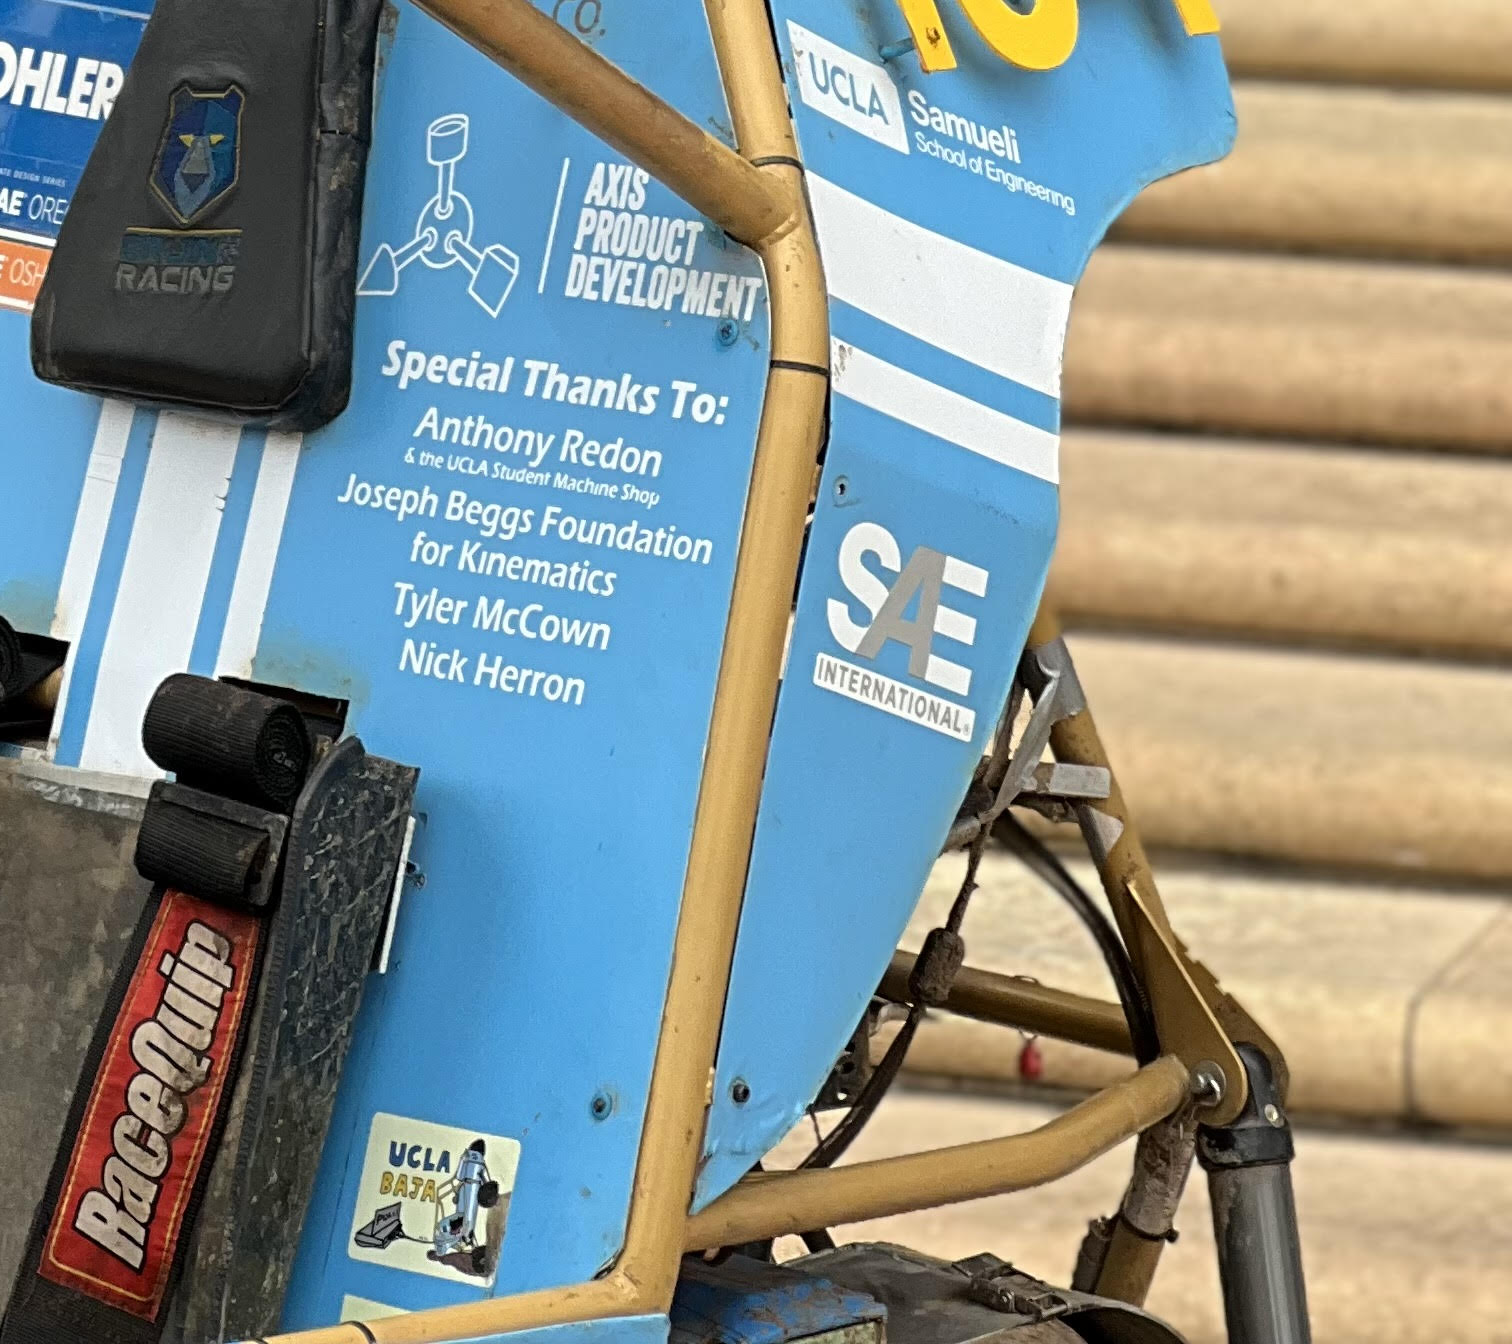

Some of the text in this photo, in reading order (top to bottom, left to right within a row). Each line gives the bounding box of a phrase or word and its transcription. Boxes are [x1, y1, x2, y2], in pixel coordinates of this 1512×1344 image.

[807, 52, 890, 126] UCLA
[907, 89, 1021, 164] Samueli
[583, 162, 650, 211] AXIS
[915, 131, 1076, 216] School of Engineering
[573, 207, 705, 266] PRODUCT
[115, 263, 236, 295] RACING
[564, 253, 763, 323] DEVELOPMENT
[381, 339, 730, 426] Special Thanks To:
[413, 406, 663, 478] Anthony Redon
[403, 446, 661, 511] & the UCLA Student Machine Shop
[337, 473, 713, 566] Joseph Beggs Foundation
[410, 530, 618, 598] for Kinematics
[393, 581, 612, 651] Tyler McCown
[826, 521, 990, 697] SAE
[398, 637, 586, 706] Nick Herron
[73, 918, 236, 1273] RaceQuip
[379, 1171, 437, 1203] BAJA
[389, 1140, 451, 1174] UCLA
